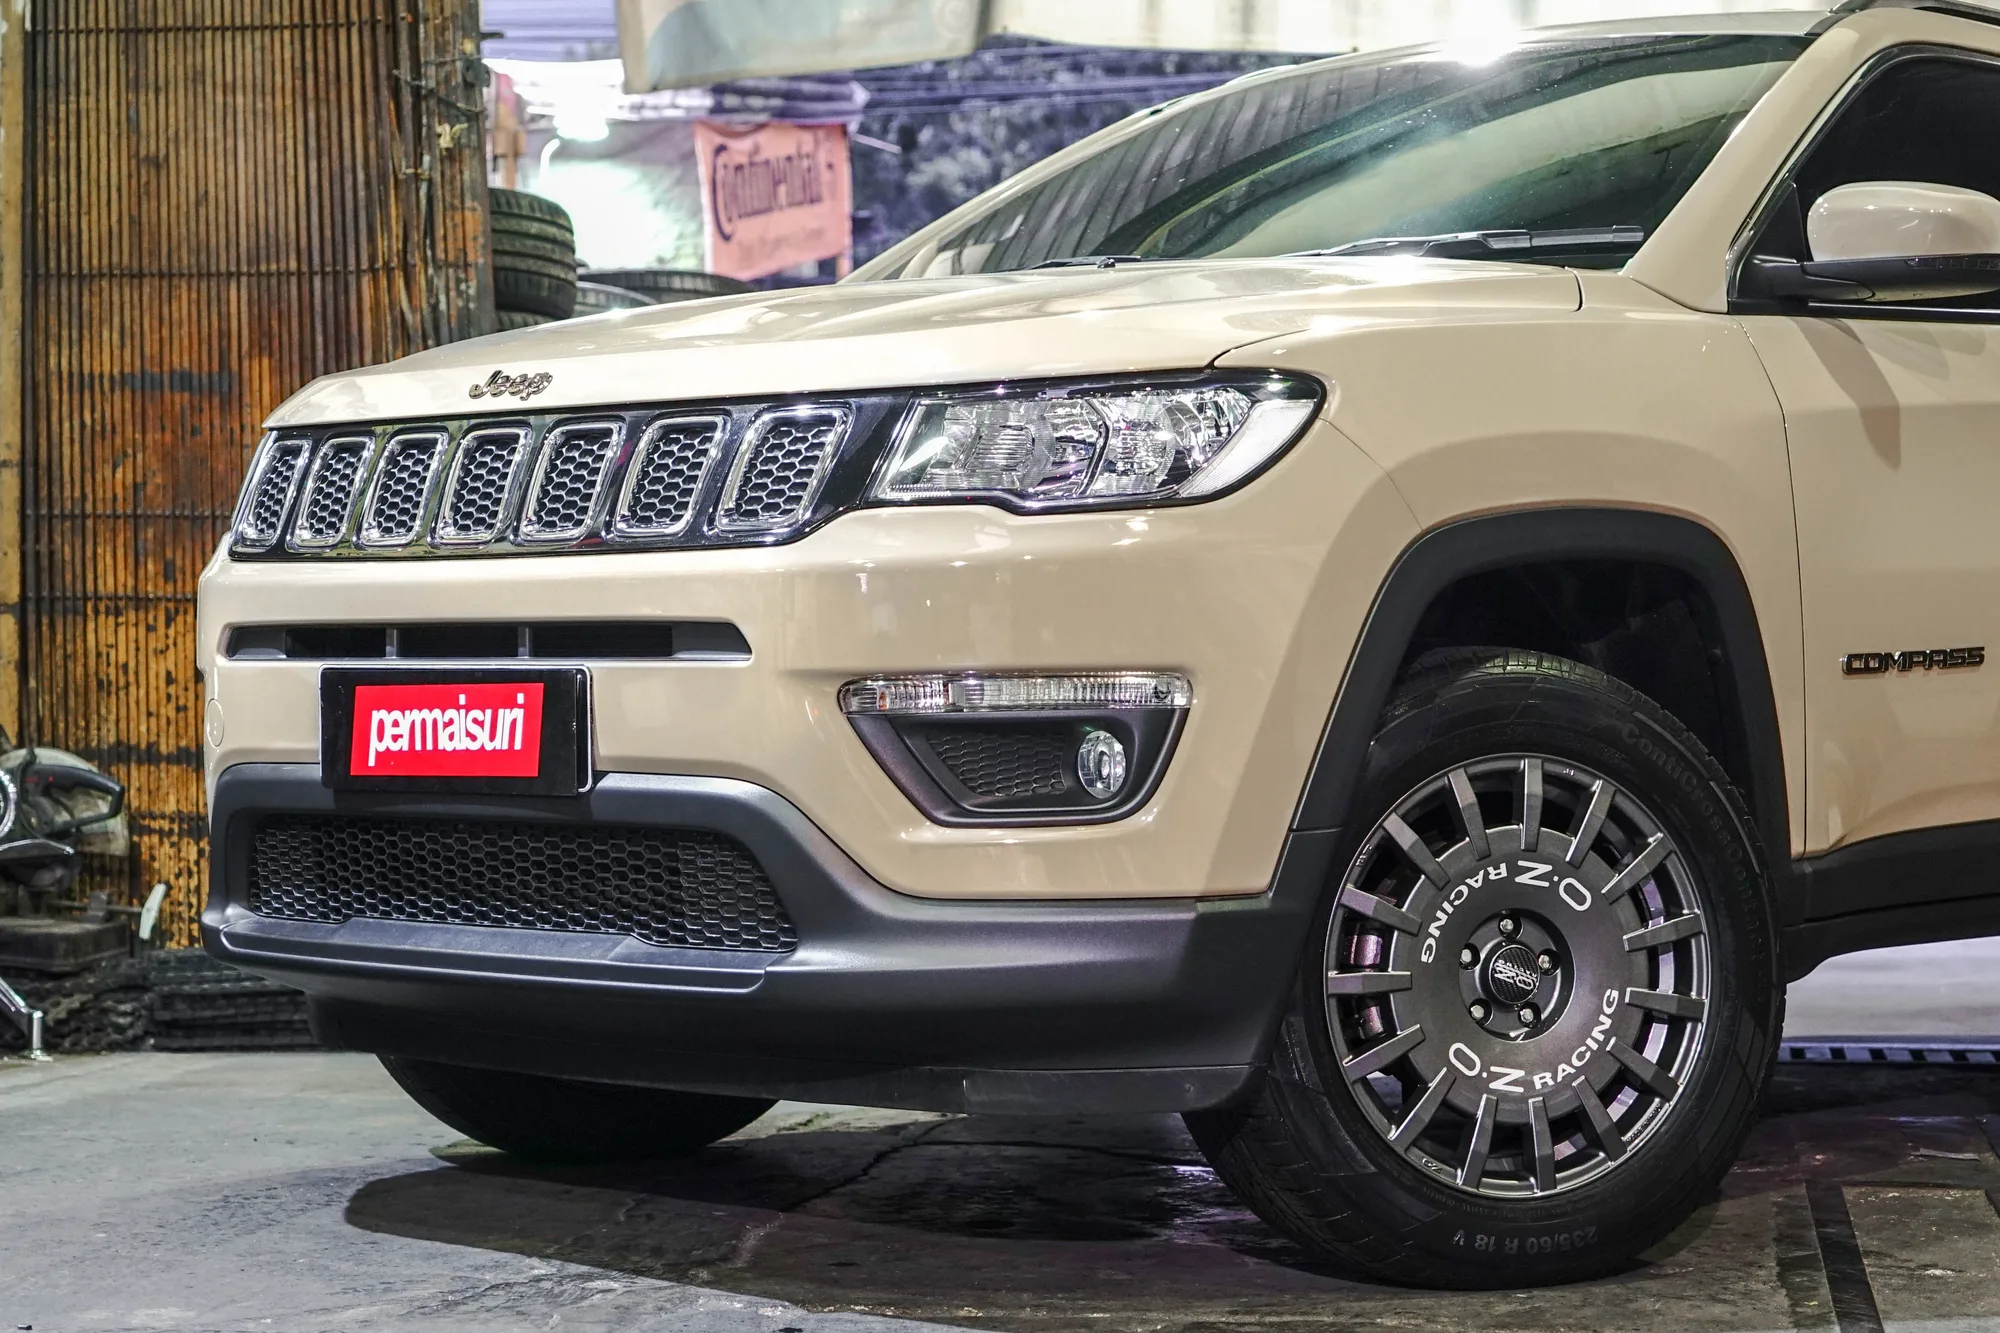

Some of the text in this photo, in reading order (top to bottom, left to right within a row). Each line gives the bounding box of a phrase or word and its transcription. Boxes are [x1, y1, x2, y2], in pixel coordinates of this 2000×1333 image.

[468, 369, 553, 402] Jeep
[1841, 646, 1986, 676] COMPASS
[367, 692, 525, 767] permaisuri
[1420, 862, 1508, 964] RACING
[1532, 988, 1620, 1090] RACING
[1474, 1234, 1497, 1252] 18
[1504, 1236, 1519, 1255] R
[1525, 1225, 1598, 1256] 235/60
